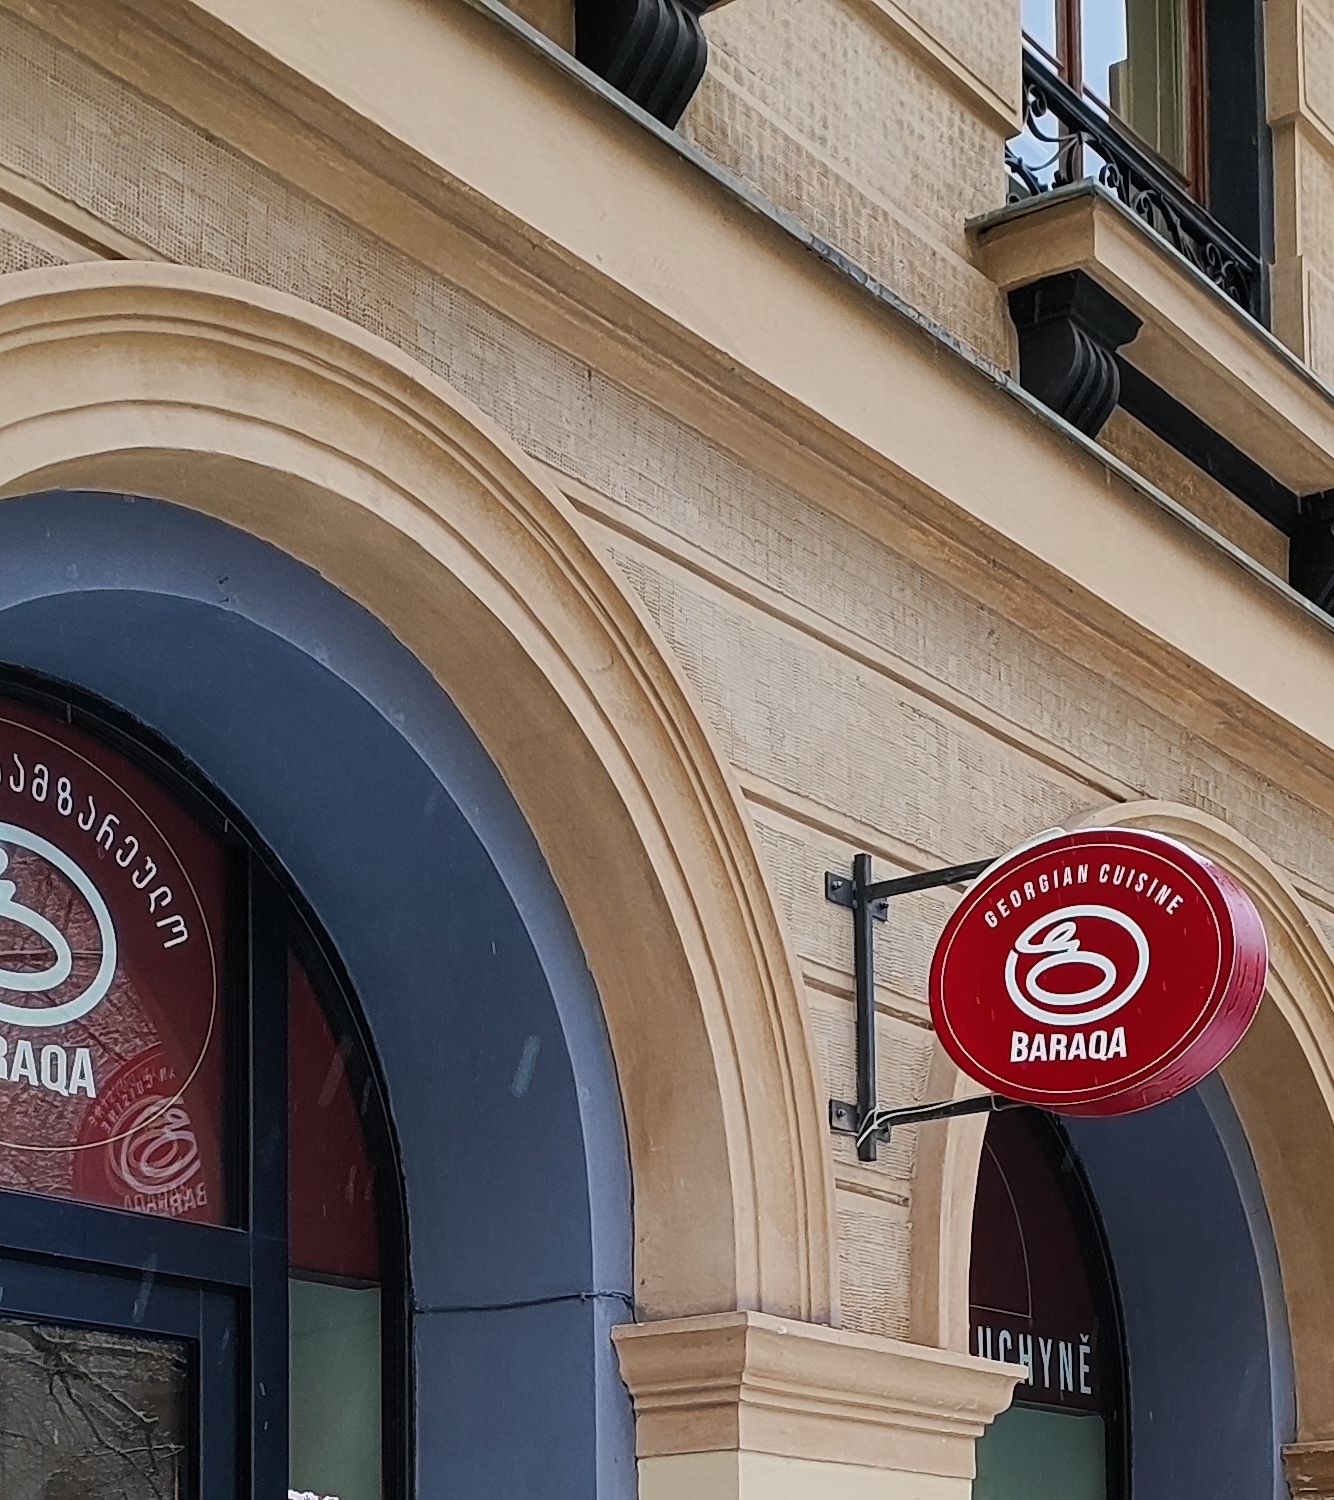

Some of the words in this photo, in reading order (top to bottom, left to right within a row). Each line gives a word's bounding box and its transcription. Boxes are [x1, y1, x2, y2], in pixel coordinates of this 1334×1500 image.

[983, 863, 1089, 929] GEORGIAN
[1098, 863, 1185, 916] CUISINE
[1009, 1026, 1128, 1063] BARAQA
[977, 1325, 1092, 1395] UCHYNĚ
